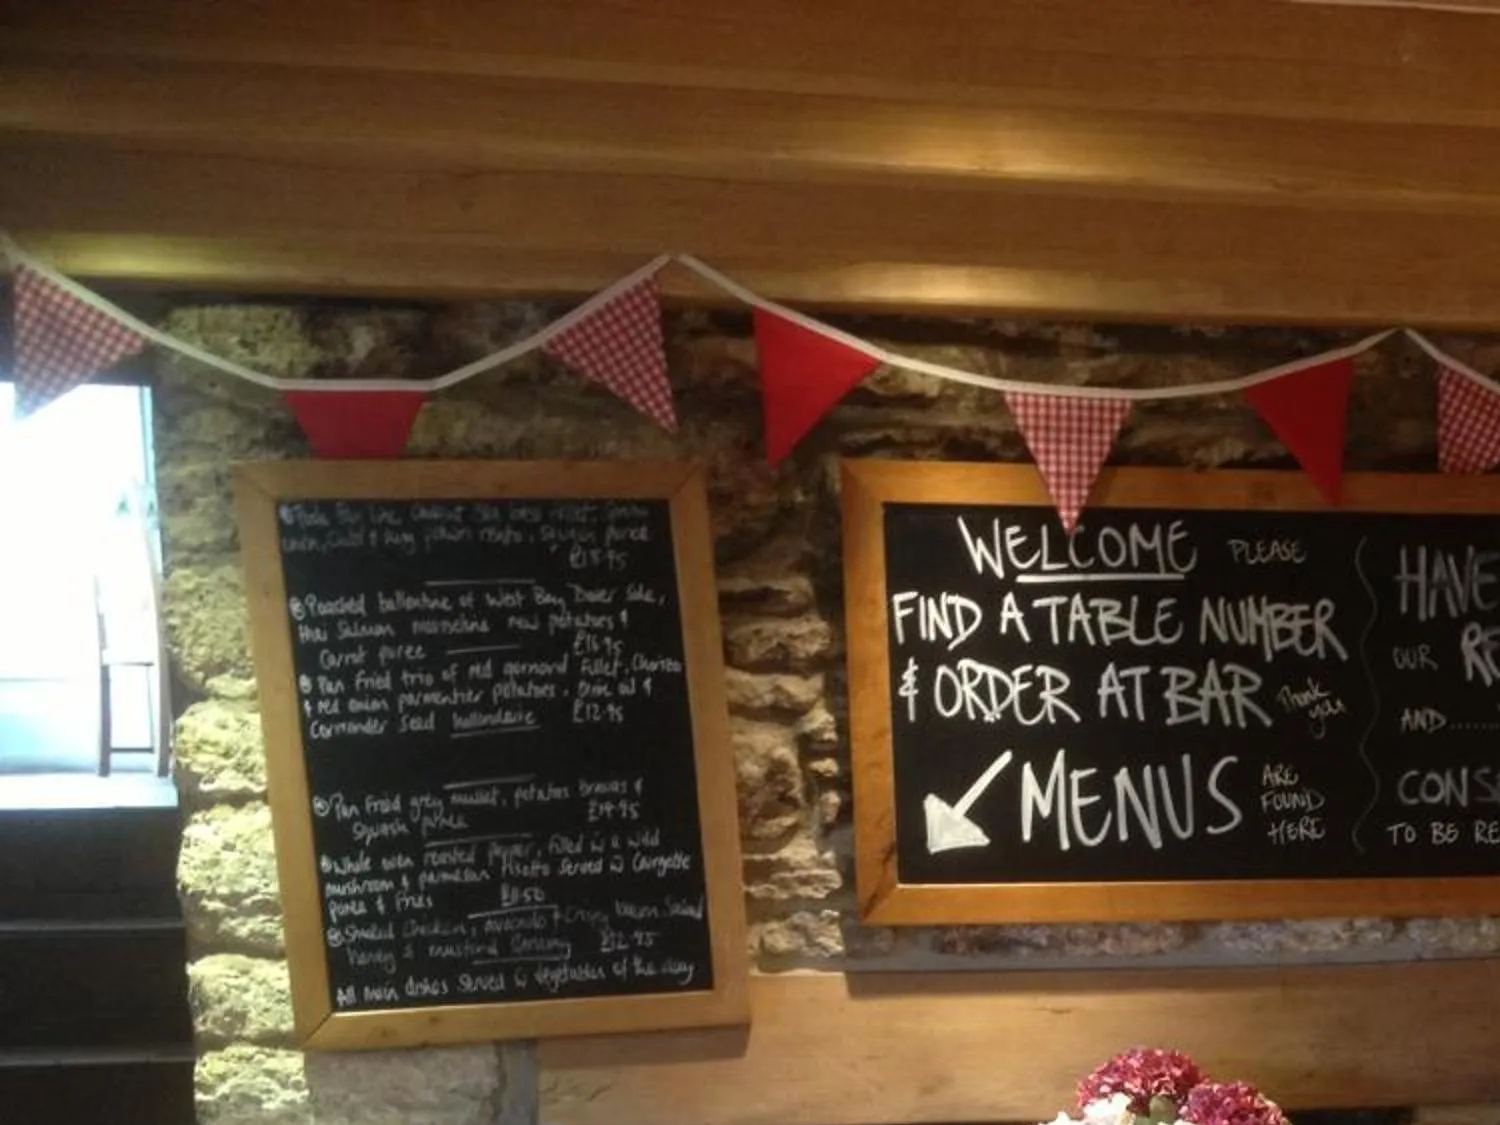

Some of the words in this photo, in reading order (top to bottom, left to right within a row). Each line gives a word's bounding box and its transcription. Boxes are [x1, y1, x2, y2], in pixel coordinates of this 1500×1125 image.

[1227, 537, 1307, 566] PLEASE
[892, 591, 982, 651] FIND
[999, 591, 1031, 646] A
[1032, 592, 1186, 648] TABLE
[1199, 594, 1350, 662] NUMBER
[1392, 645, 1439, 671] OUR
[442, 661, 459, 684] of
[897, 656, 920, 724] &
[934, 657, 1082, 727] ORDER
[1097, 661, 1151, 722] AT
[1161, 658, 1273, 729] BAR
[1307, 699, 1348, 740] you
[1020, 747, 1244, 852] MENUS
[1261, 763, 1299, 787] ARE
[1260, 789, 1326, 811] FOUND
[1267, 817, 1327, 844] HERE
[1387, 822, 1417, 846] TO
[1430, 821, 1460, 844] BE
